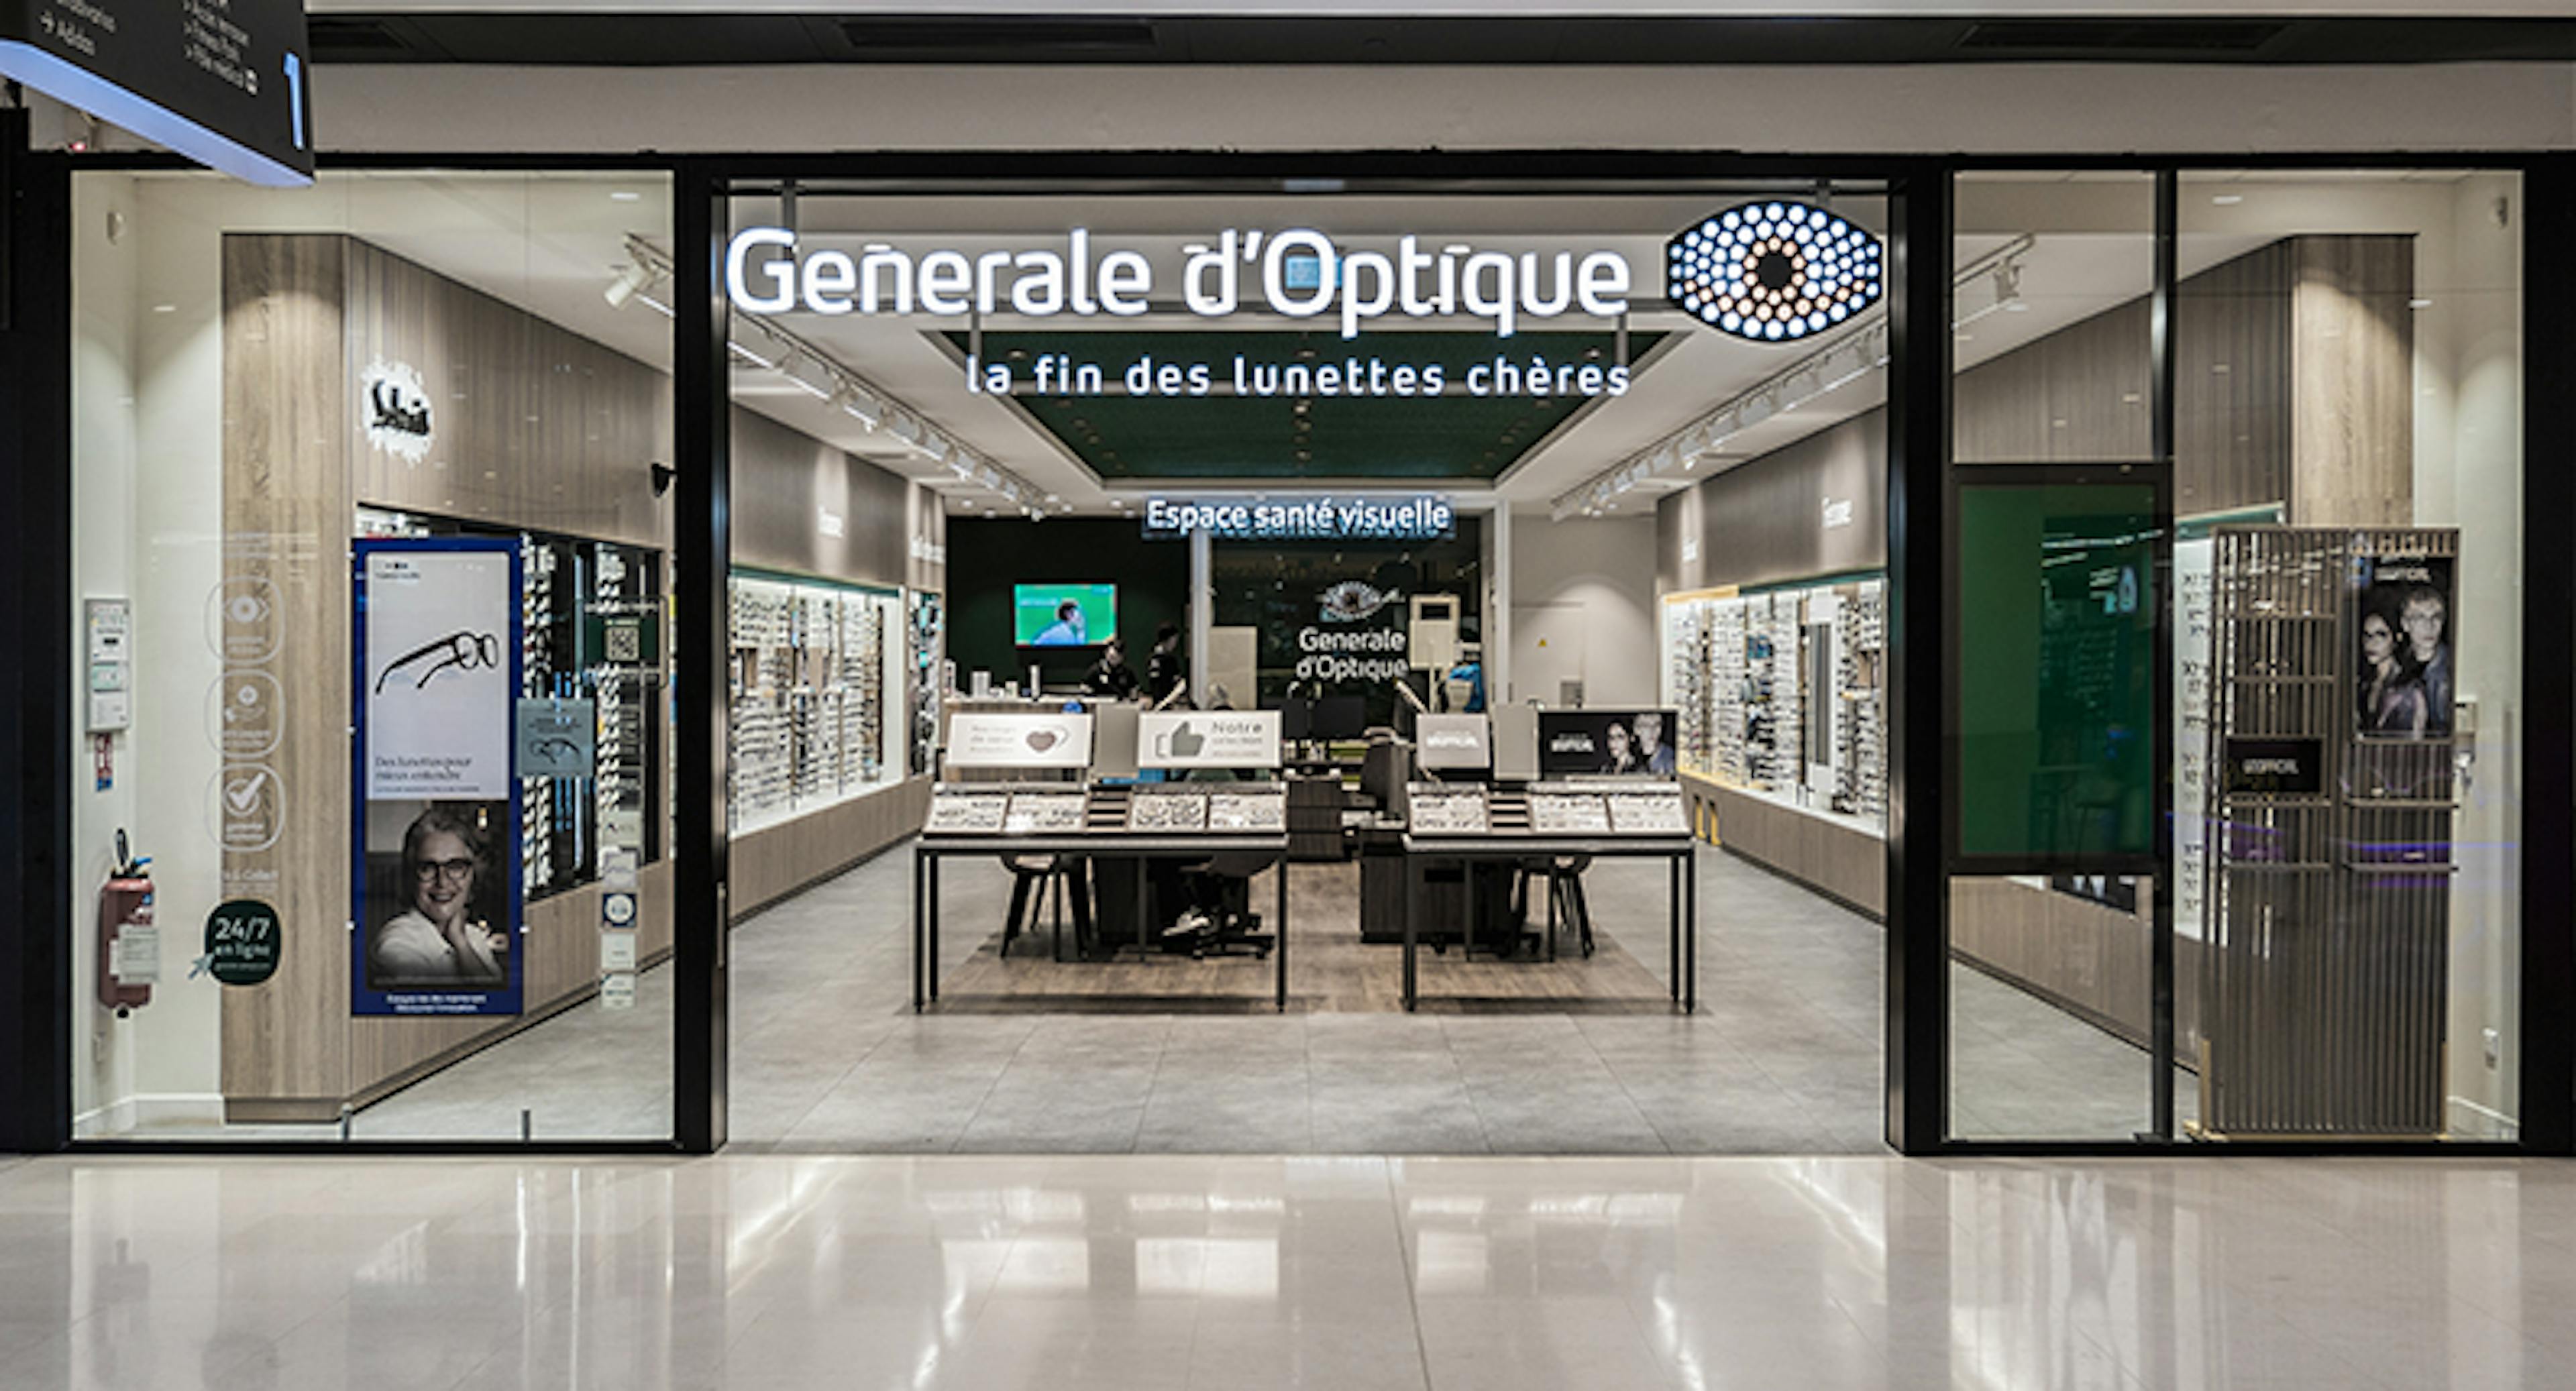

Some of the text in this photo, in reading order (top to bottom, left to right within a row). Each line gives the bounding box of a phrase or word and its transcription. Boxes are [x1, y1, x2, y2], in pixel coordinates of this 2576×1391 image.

[283, 52, 303, 150] 1
[726, 226, 1630, 339] Generale d'Optique
[966, 354, 1630, 396] la fin des lunettes chères
[1146, 497, 1451, 535] Espace santé visuelle
[1299, 627, 1406, 651] Generale
[1295, 654, 1409, 683] d'Optique
[215, 916, 270, 941] 24/7
